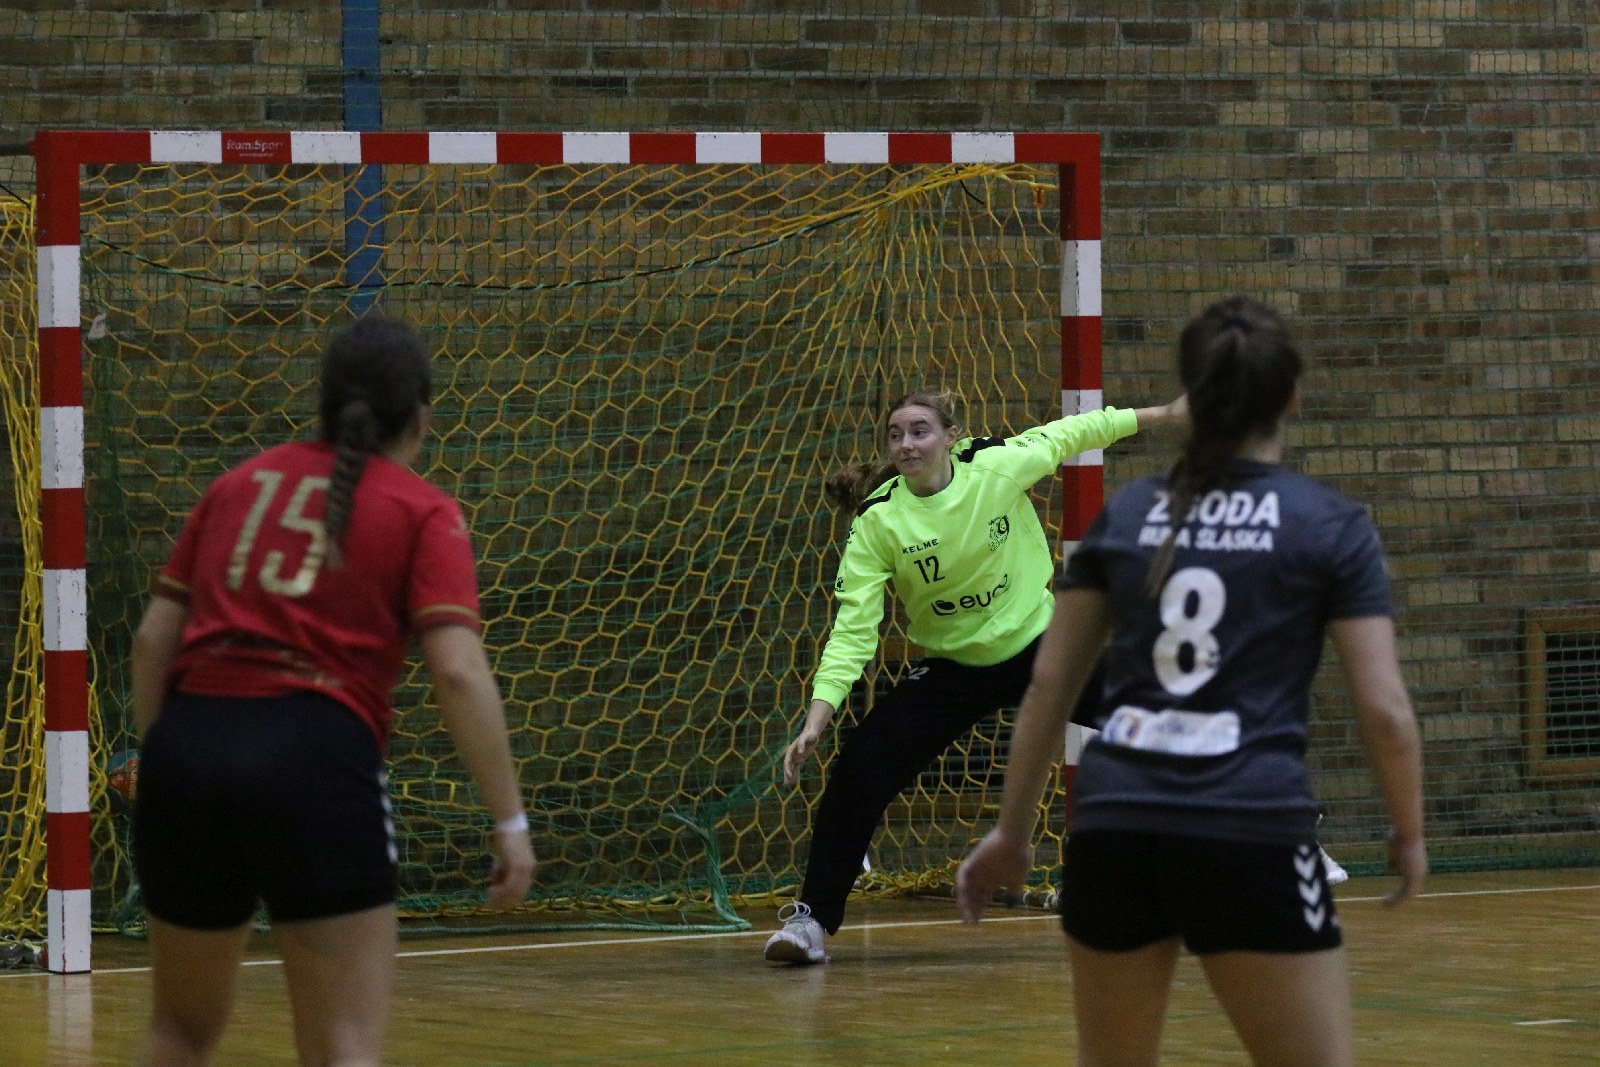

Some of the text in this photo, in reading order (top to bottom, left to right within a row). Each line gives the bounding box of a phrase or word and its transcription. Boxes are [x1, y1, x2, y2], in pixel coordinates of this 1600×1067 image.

[1145, 490, 1280, 528] ZODA
[226, 469, 331, 597] 15
[902, 538, 940, 554] KELME
[1138, 525, 1191, 550] RUA
[913, 555, 946, 584] 12
[1152, 566, 1227, 697] 8
